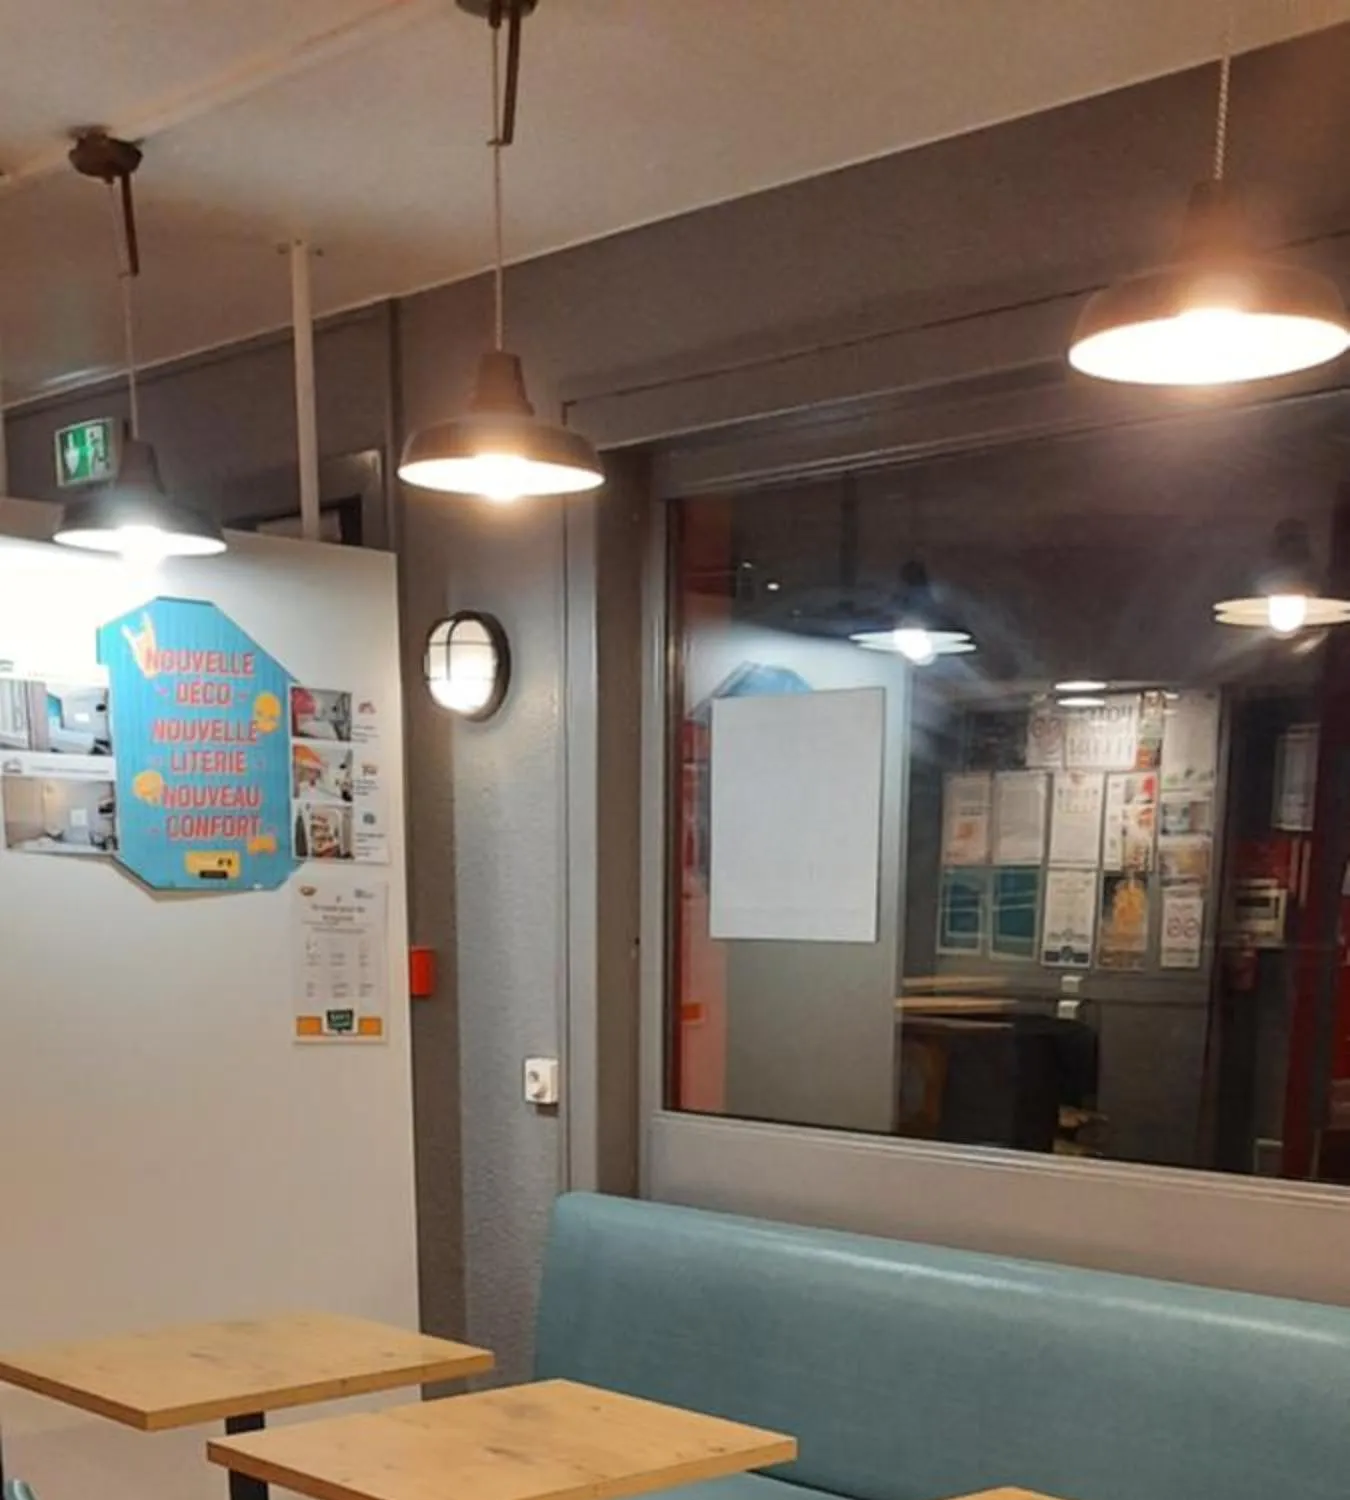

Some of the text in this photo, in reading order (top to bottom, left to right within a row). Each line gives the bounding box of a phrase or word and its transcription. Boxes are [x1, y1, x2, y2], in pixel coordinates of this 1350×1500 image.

[144, 648, 255, 677] NOUVELLE
[175, 679, 232, 705] DÉCO
[153, 718, 258, 745] NOUVELLE
[171, 750, 247, 774] LITERIE
[162, 783, 260, 808] NOUVEAU
[166, 813, 261, 839] CONFORT
